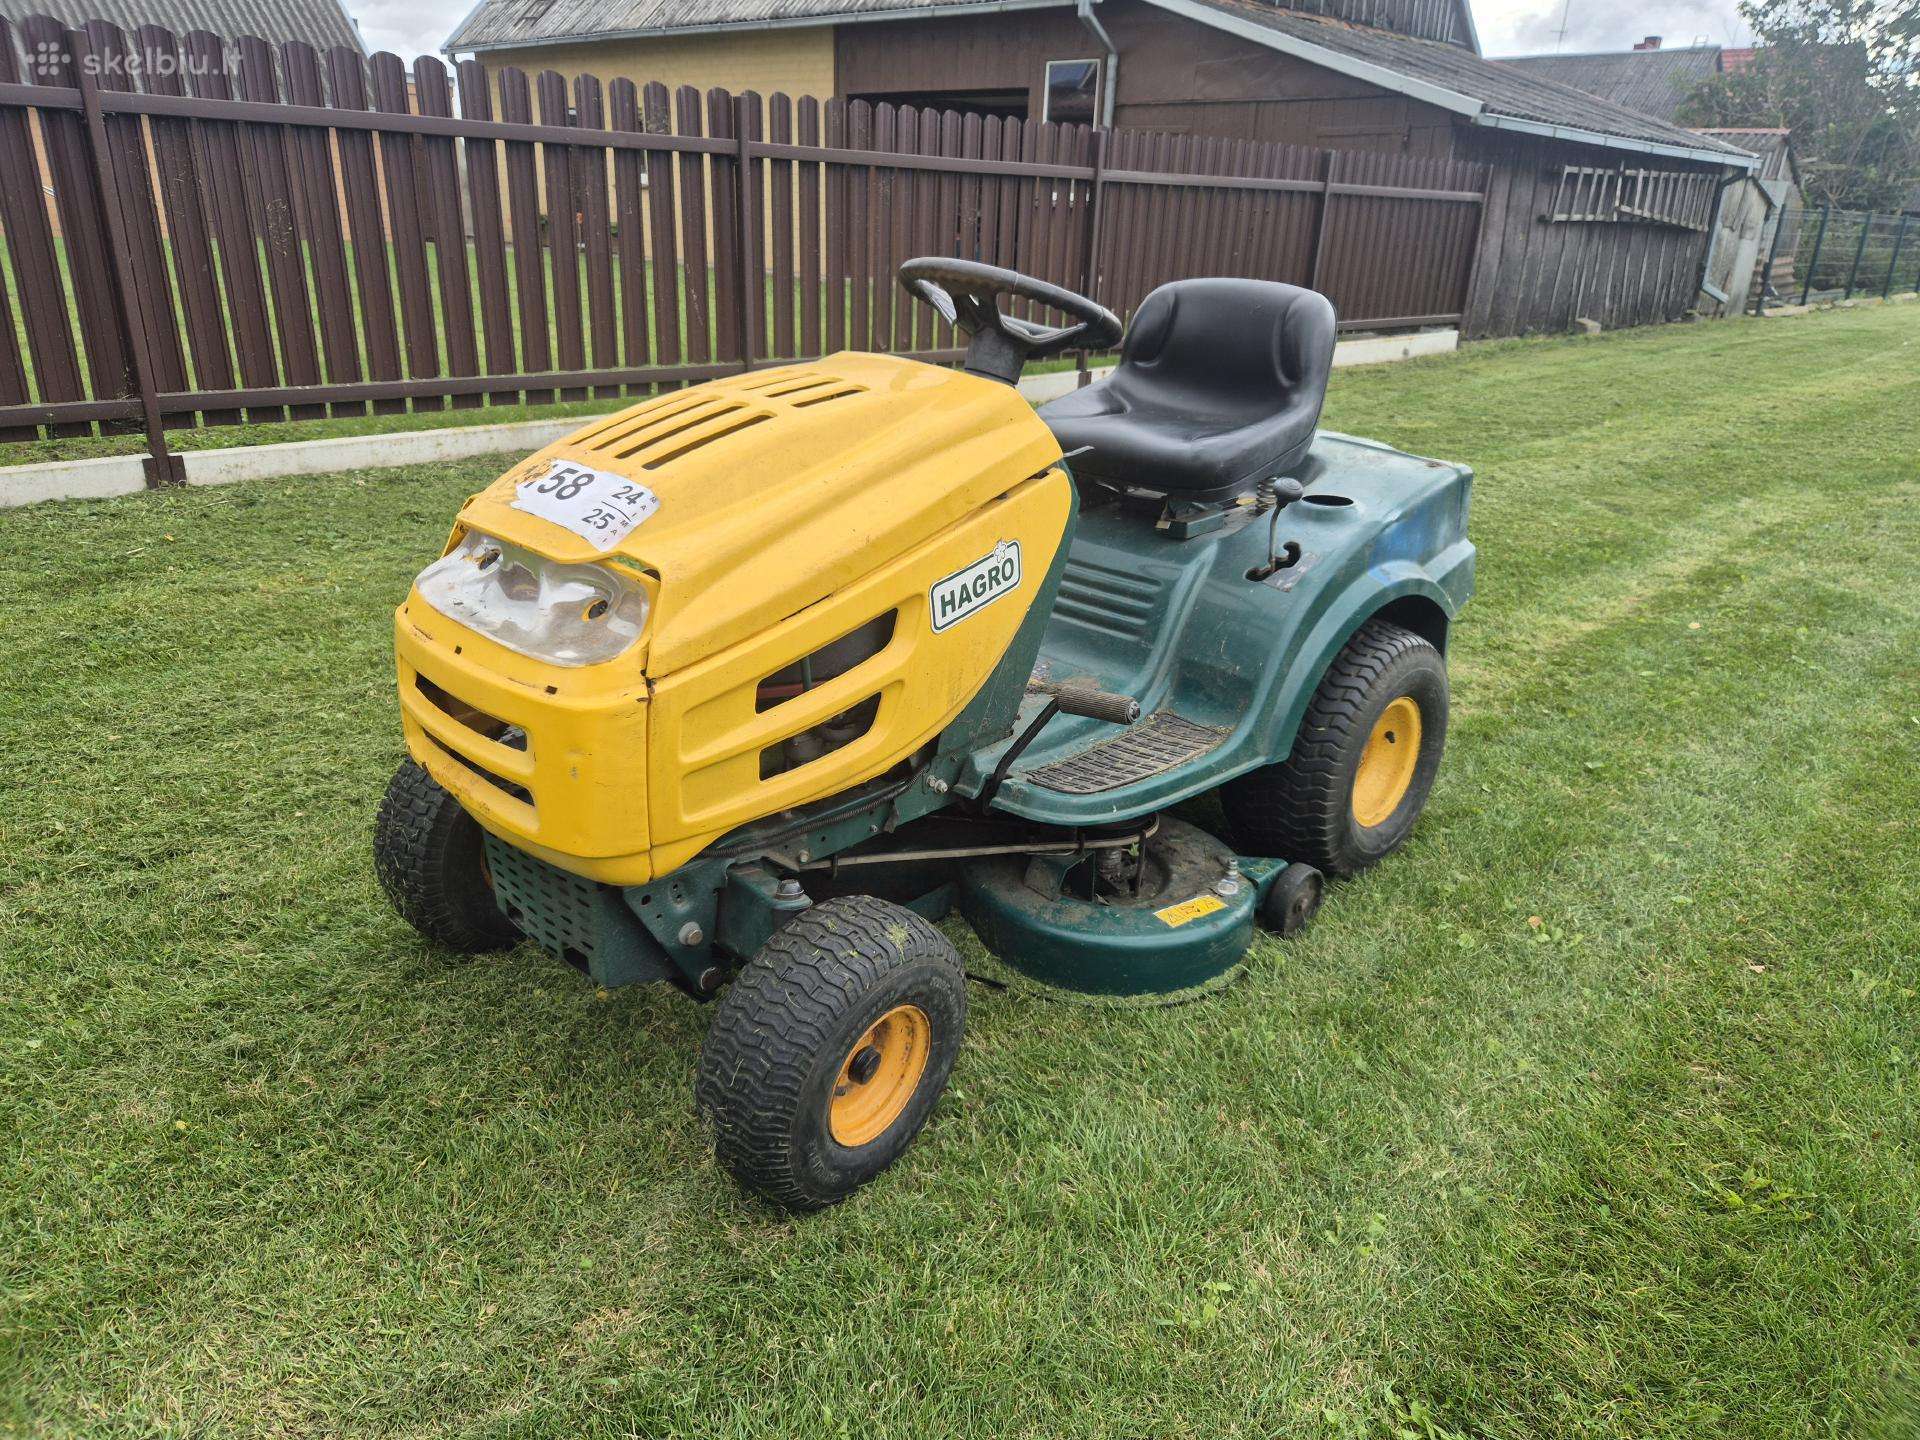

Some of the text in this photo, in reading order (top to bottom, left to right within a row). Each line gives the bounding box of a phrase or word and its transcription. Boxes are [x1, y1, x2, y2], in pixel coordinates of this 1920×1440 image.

[523, 463, 595, 500] 58
[611, 485, 645, 505] 24
[581, 508, 616, 530] 25
[940, 557, 1015, 618] HAGRO
